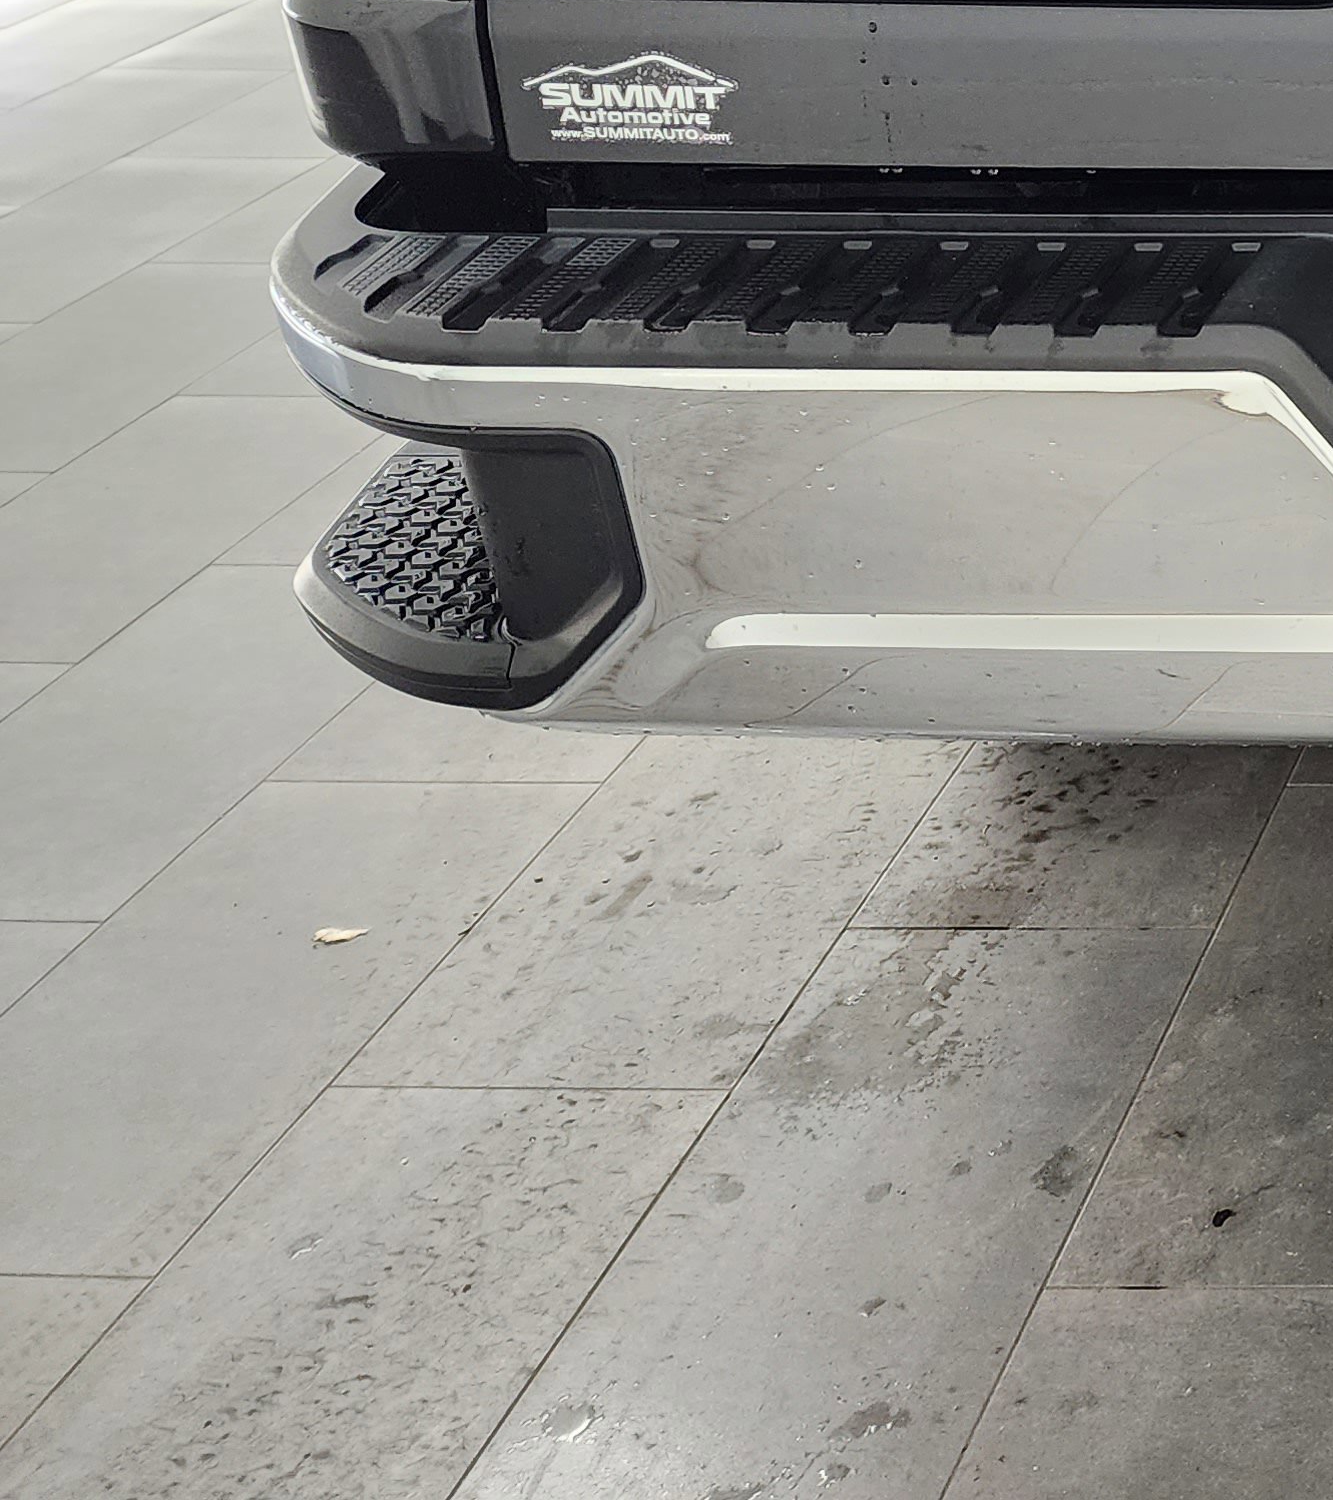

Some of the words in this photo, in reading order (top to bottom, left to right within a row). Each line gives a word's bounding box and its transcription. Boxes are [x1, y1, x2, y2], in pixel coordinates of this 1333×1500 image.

[538, 83, 726, 109] SUMMIT
[560, 107, 711, 126] Automotive
[551, 126, 732, 142] www.SUMMITAUTO.com
